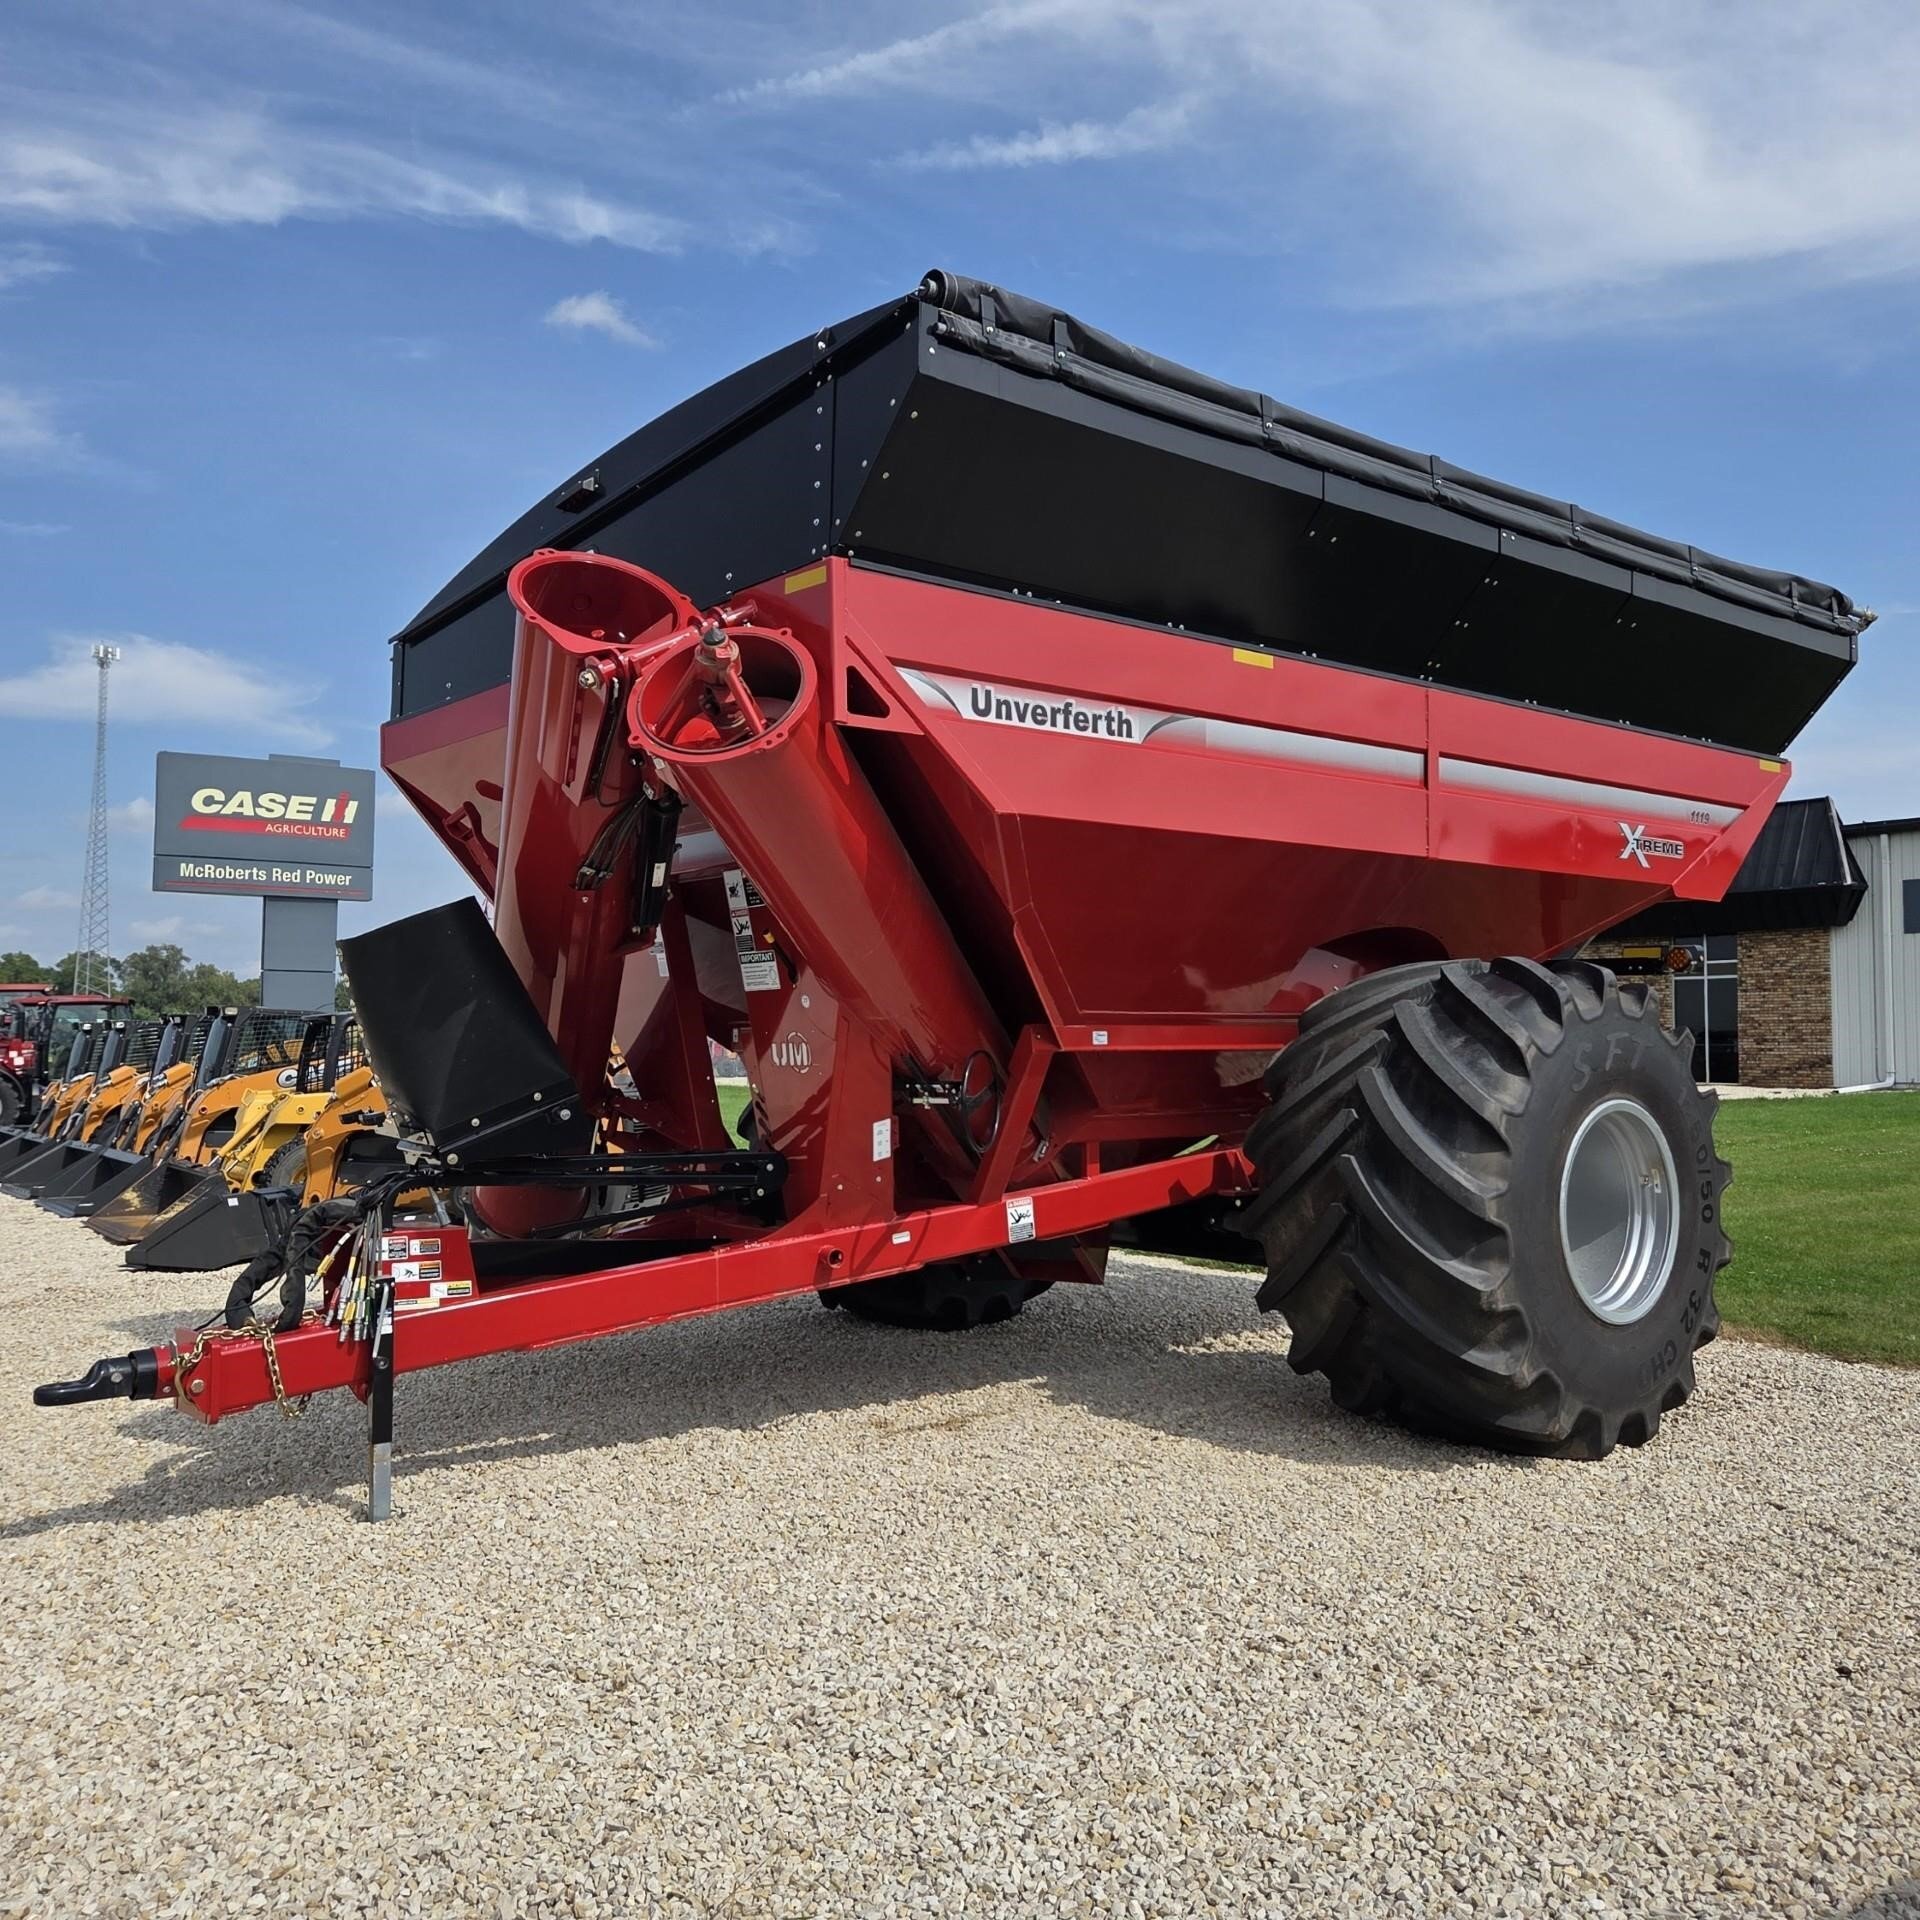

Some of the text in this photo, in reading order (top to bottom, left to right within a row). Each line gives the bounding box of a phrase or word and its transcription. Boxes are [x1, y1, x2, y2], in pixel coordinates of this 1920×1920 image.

[969, 686, 1133, 739] Unverferth
[191, 788, 317, 820] CASE
[1690, 810, 1710, 824] 1119
[265, 823, 346, 838] AGRICULTURE
[179, 863, 352, 886] McRoberts Red Power
[741, 952, 773, 963] IMPORTANT
[1680, 1289, 1702, 1334] 32
